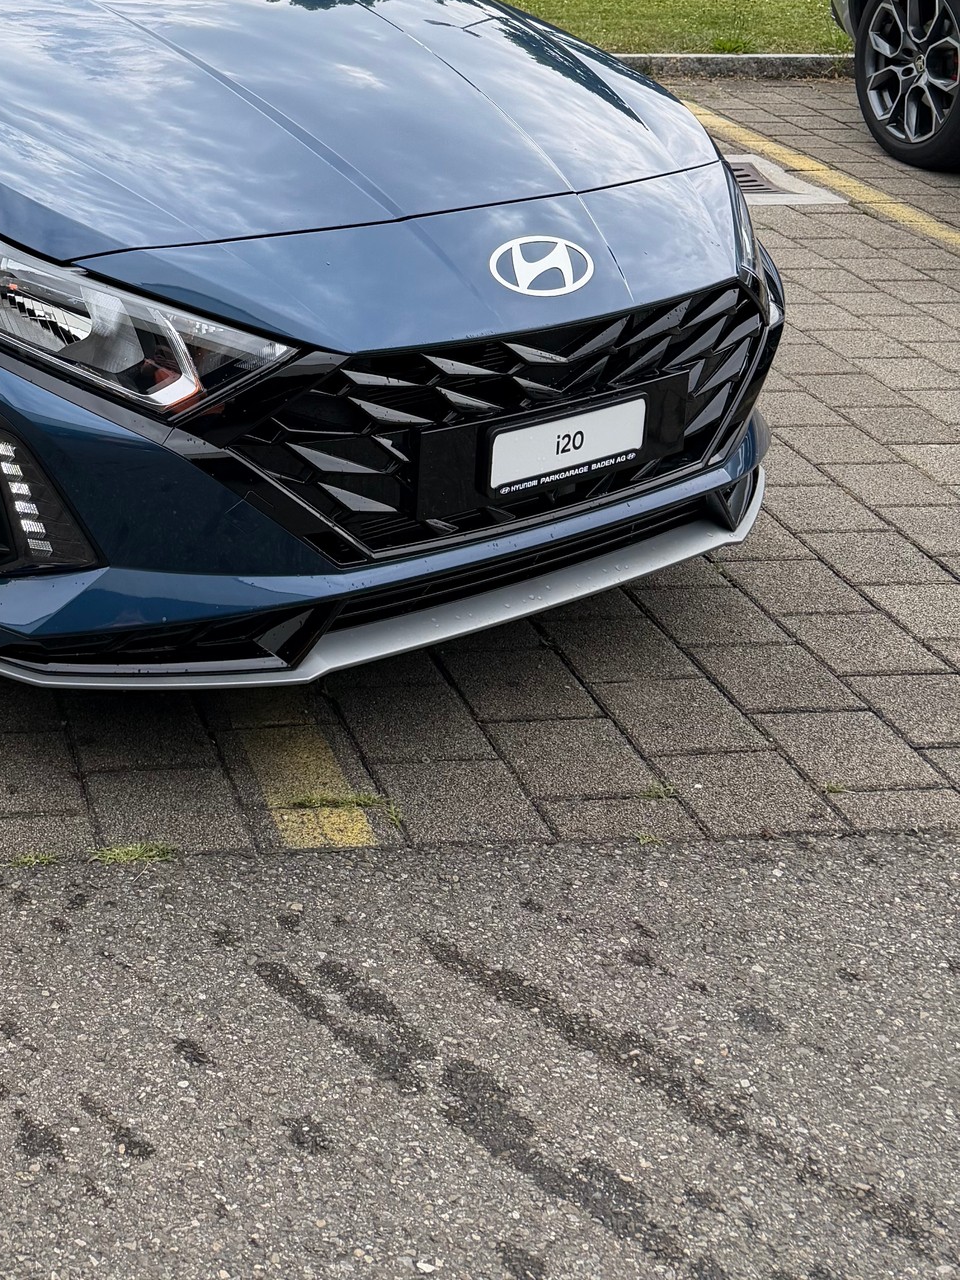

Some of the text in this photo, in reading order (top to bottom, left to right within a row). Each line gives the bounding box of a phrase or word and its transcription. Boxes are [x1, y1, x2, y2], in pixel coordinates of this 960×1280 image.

[555, 430, 584, 455] i20
[511, 454, 626, 491] HYUNDAI PARKGARAGE BADEN AG
